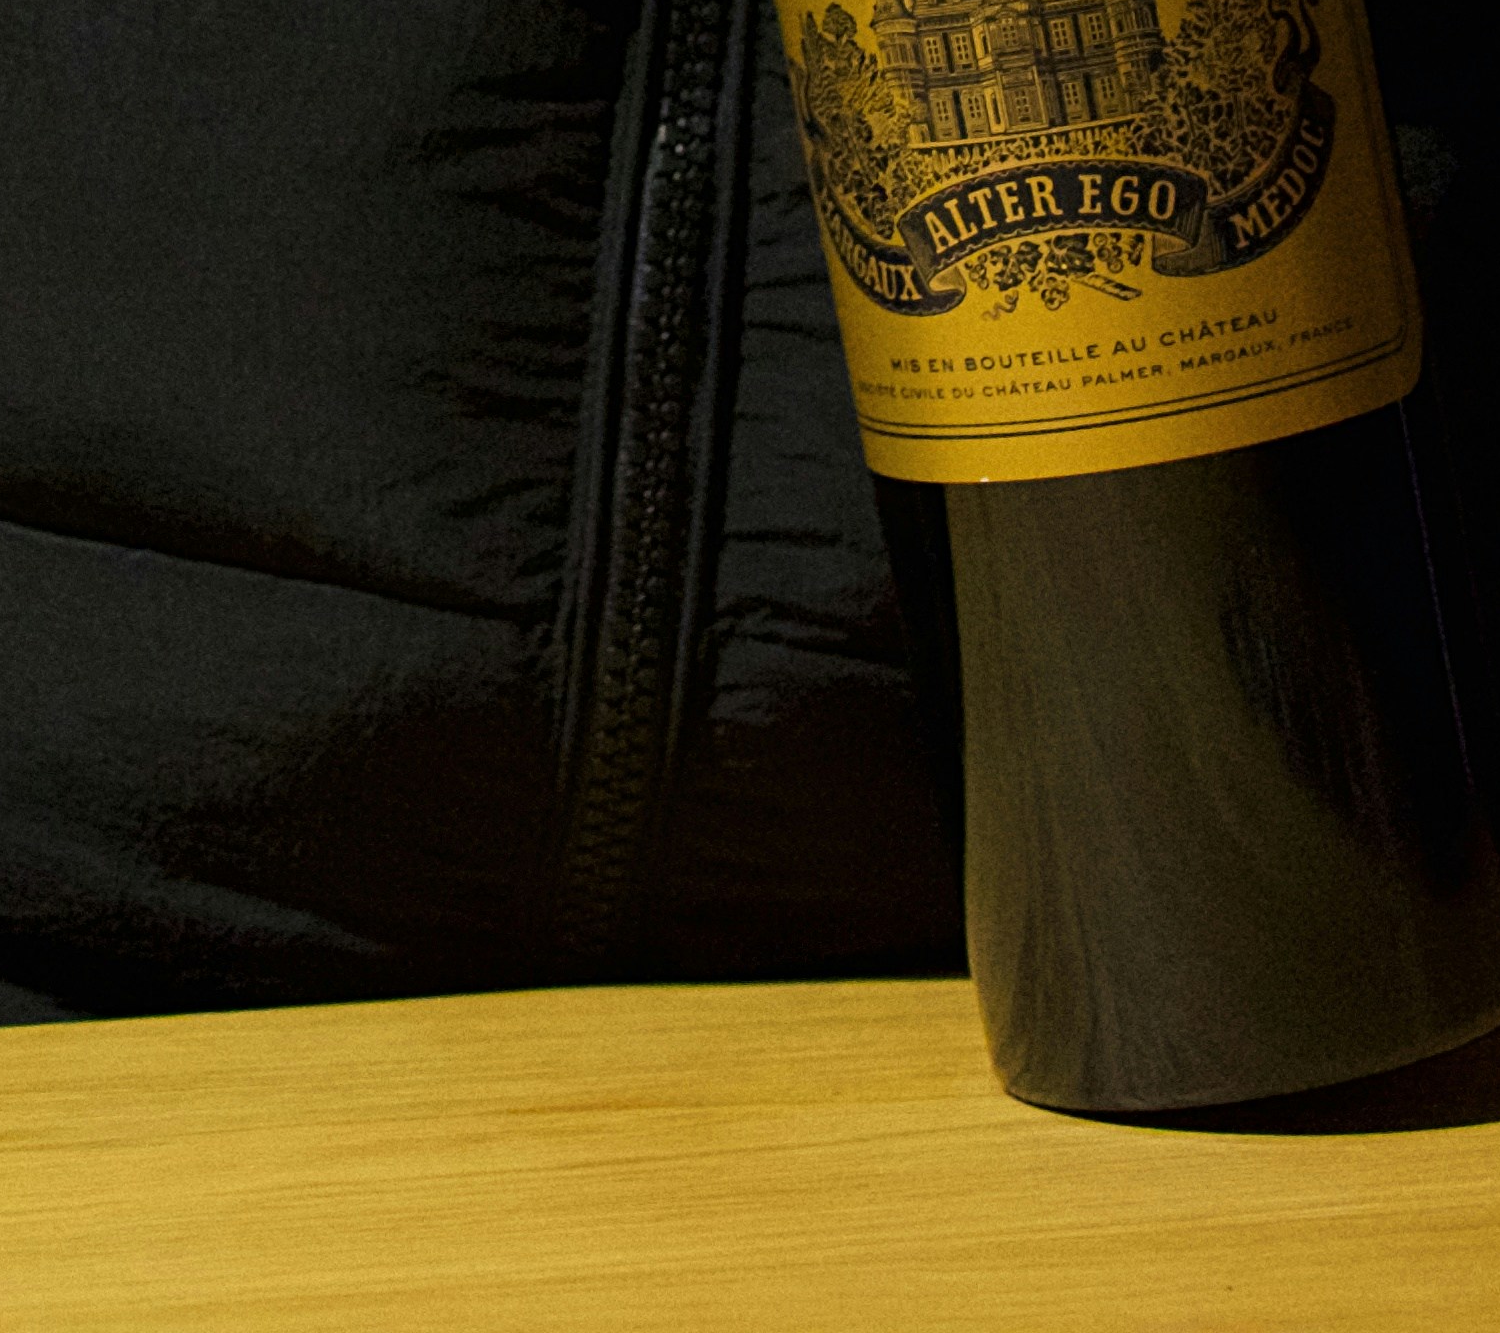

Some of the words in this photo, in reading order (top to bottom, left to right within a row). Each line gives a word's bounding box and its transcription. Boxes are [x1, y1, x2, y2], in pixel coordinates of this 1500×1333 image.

[924, 175, 1064, 255] ALTER
[1077, 173, 1177, 221] EGO
[891, 358, 921, 373] MIS
[928, 358, 954, 373] EN
[964, 343, 1100, 372] BOUTEILLE
[1112, 336, 1146, 356] AU
[1159, 308, 1278, 347] CHÂTEAU
[901, 385, 945, 400] CIVILE
[952, 384, 975, 399] DU
[982, 378, 1071, 398] CHÂTEAU
[1289, 316, 1354, 347] FRANCE
